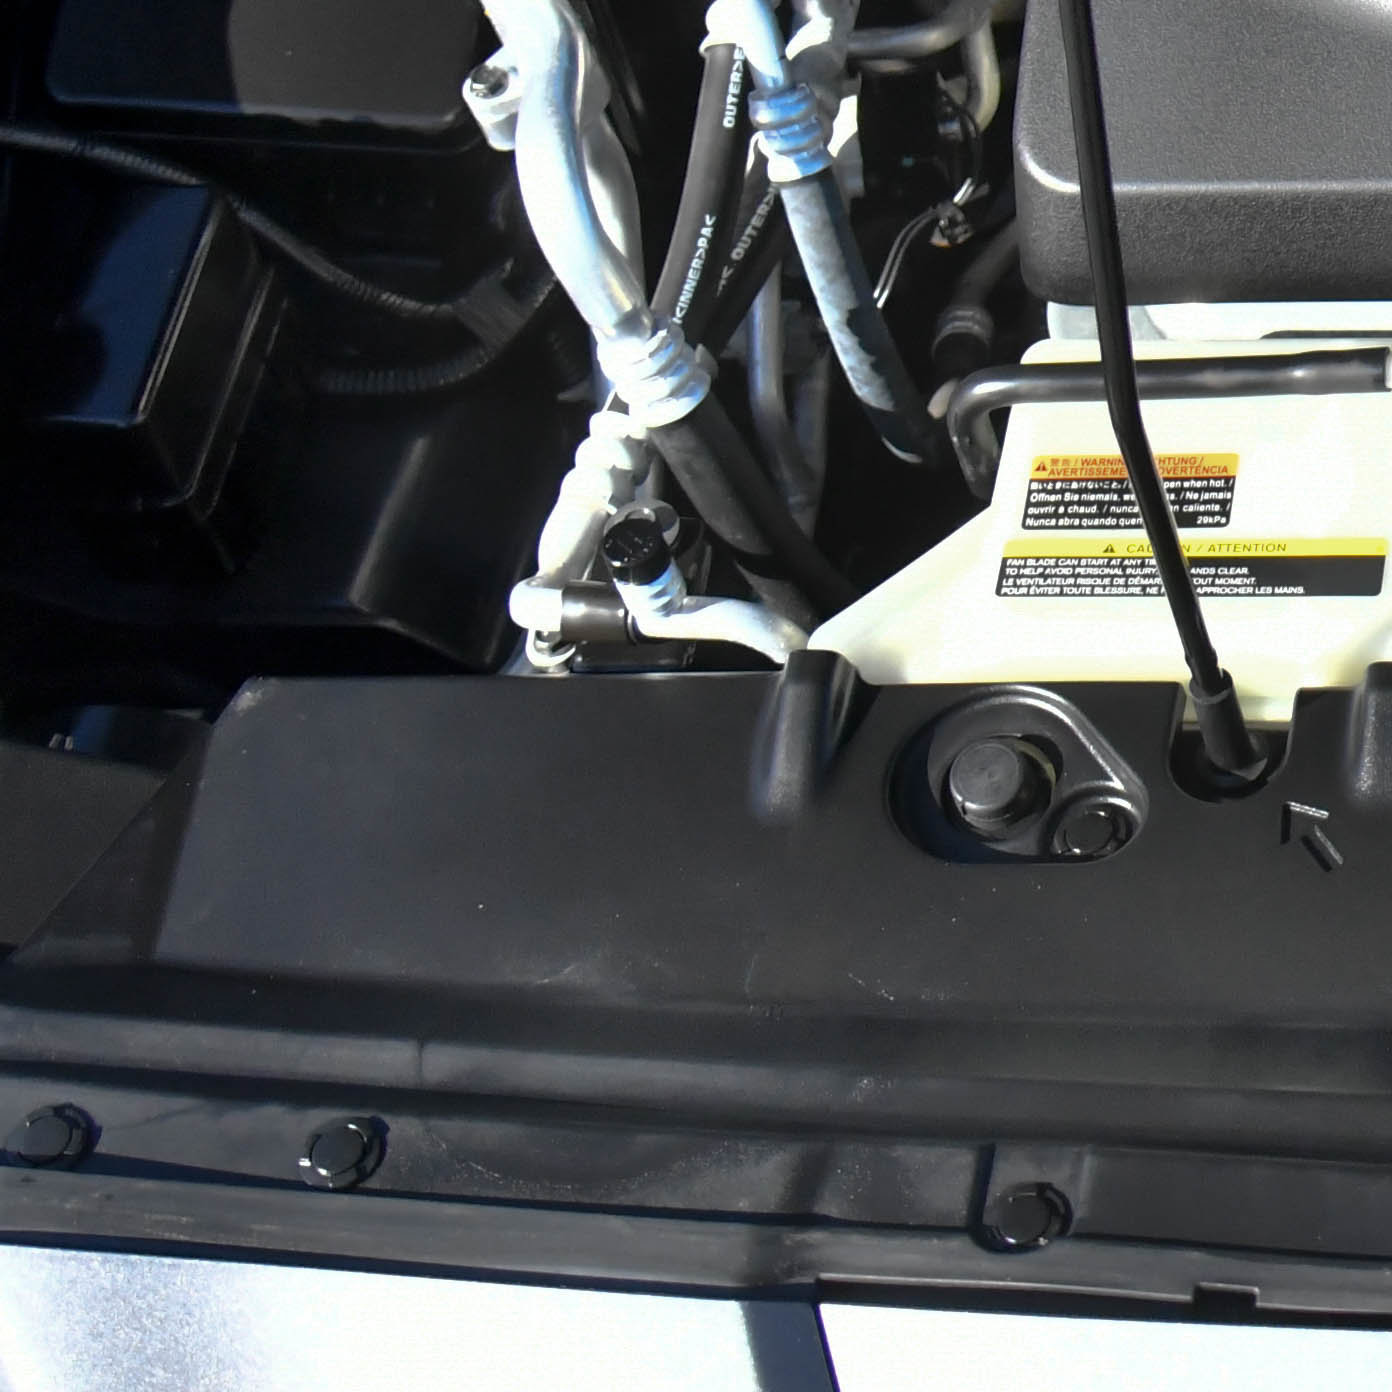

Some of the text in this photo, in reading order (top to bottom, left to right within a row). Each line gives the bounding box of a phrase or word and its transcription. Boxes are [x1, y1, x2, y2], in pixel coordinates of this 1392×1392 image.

[1081, 458, 1125, 466] WARNIN
[1158, 457, 1197, 465] HTUNG
[1048, 467, 1128, 476] AVERTISSEME
[1163, 480, 1181, 488] pen
[1183, 479, 1208, 488] when
[1209, 479, 1227, 487] hot.
[1064, 492, 1079, 501] Sie
[1185, 491, 1199, 500] Ne
[1200, 491, 1232, 502] jamais
[1027, 505, 1056, 514] ouvrir
[1067, 504, 1100, 513] chaud.
[1182, 503, 1223, 512] caliente.
[1025, 516, 1227, 527] Nunca abra quando quen 29kPa
[1208, 543, 1287, 553] ATTENTION
[1006, 558, 1025, 566] FAN
[1026, 558, 1056, 566] BLADE
[1058, 558, 1078, 566] CAN
[1080, 558, 1108, 566] START
[1110, 558, 1121, 566] AT
[1123, 558, 1142, 566] ANY
[1005, 567, 1018, 575] TO
[1020, 567, 1044, 575] HELP
[1044, 567, 1073, 575] AVOID
[1074, 567, 1124, 575] PERSONAL
[1190, 567, 1216, 575] ANDS
[1217, 567, 1249, 575] CLEAR.
[1002, 577, 1014, 585] LE
[1016, 577, 1075, 585] VENTILATEUR
[1076, 577, 1111, 585] RISQUE
[1113, 577, 1126, 585] DE
[1215, 577, 1256, 585] MOMENT.
[1001, 586, 1028, 595] POUR
[1029, 586, 1060, 595] ÉVITER
[1063, 586, 1092, 595] TOUTE
[1146, 586, 1160, 595] NE
[1196, 586, 1253, 595] APPROCHER
[1255, 586, 1272, 595] LES
[1274, 586, 1306, 595] MAINS.
